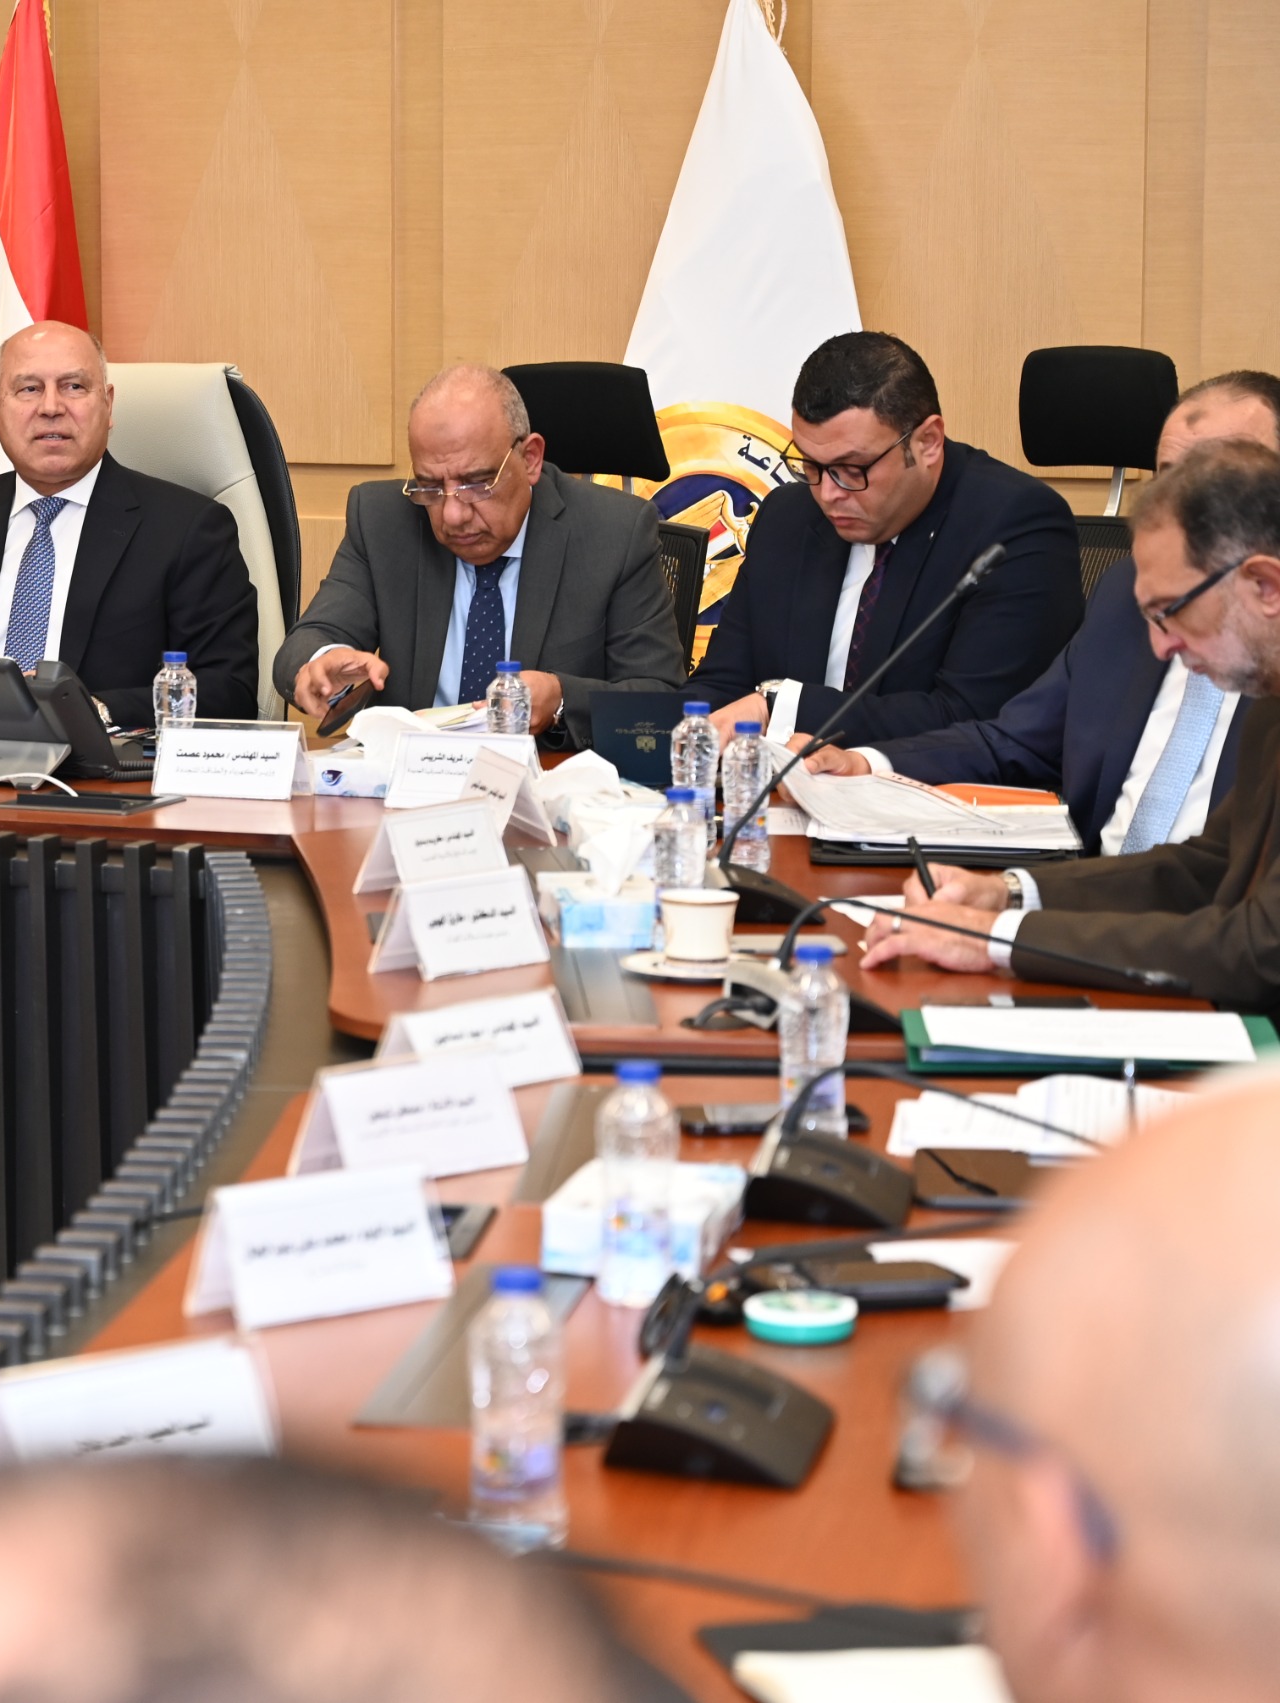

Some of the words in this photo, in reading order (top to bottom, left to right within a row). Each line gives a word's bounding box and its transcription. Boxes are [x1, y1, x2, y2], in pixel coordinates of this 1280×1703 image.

[176, 748, 200, 758] عصمت
[202, 751, 225, 760] محمود
[231, 751, 259, 761] المهندس
[260, 752, 280, 762] السيد
[446, 754, 463, 763] شريف
